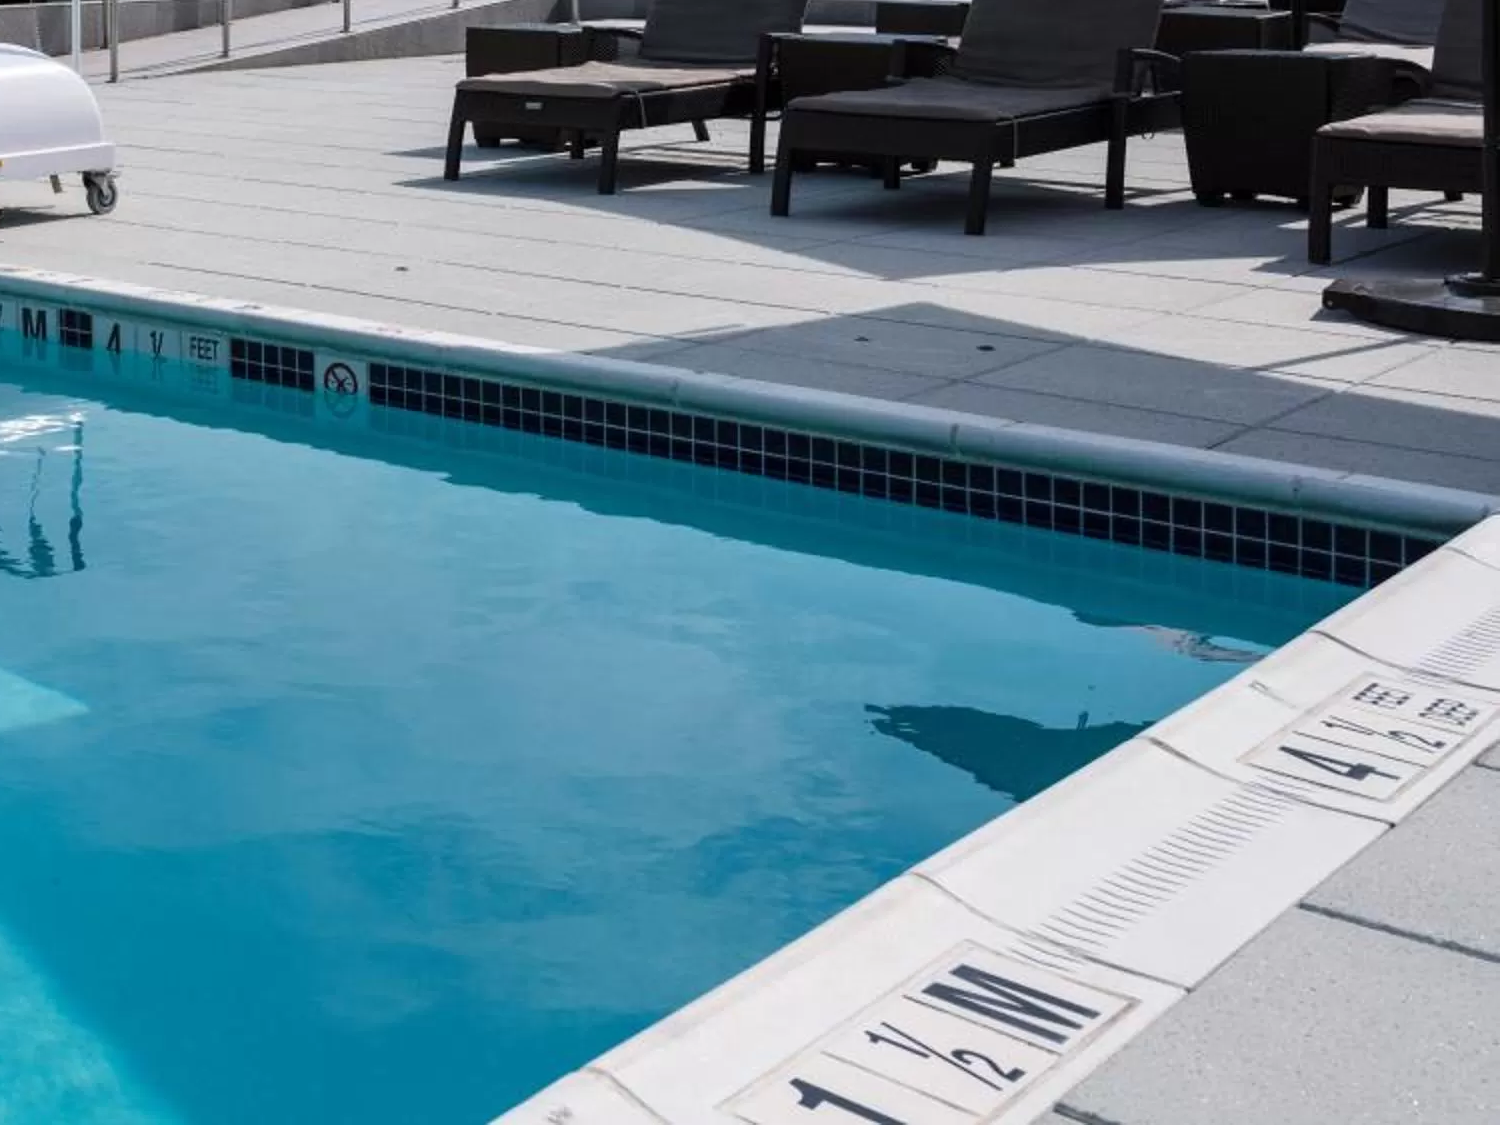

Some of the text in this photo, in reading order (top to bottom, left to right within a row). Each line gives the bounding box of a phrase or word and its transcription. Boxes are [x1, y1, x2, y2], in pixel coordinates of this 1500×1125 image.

[21, 306, 47, 341] M
[189, 336, 220, 360] FEET
[1278, 745, 1401, 781] 4
[920, 963, 1102, 1045] M
